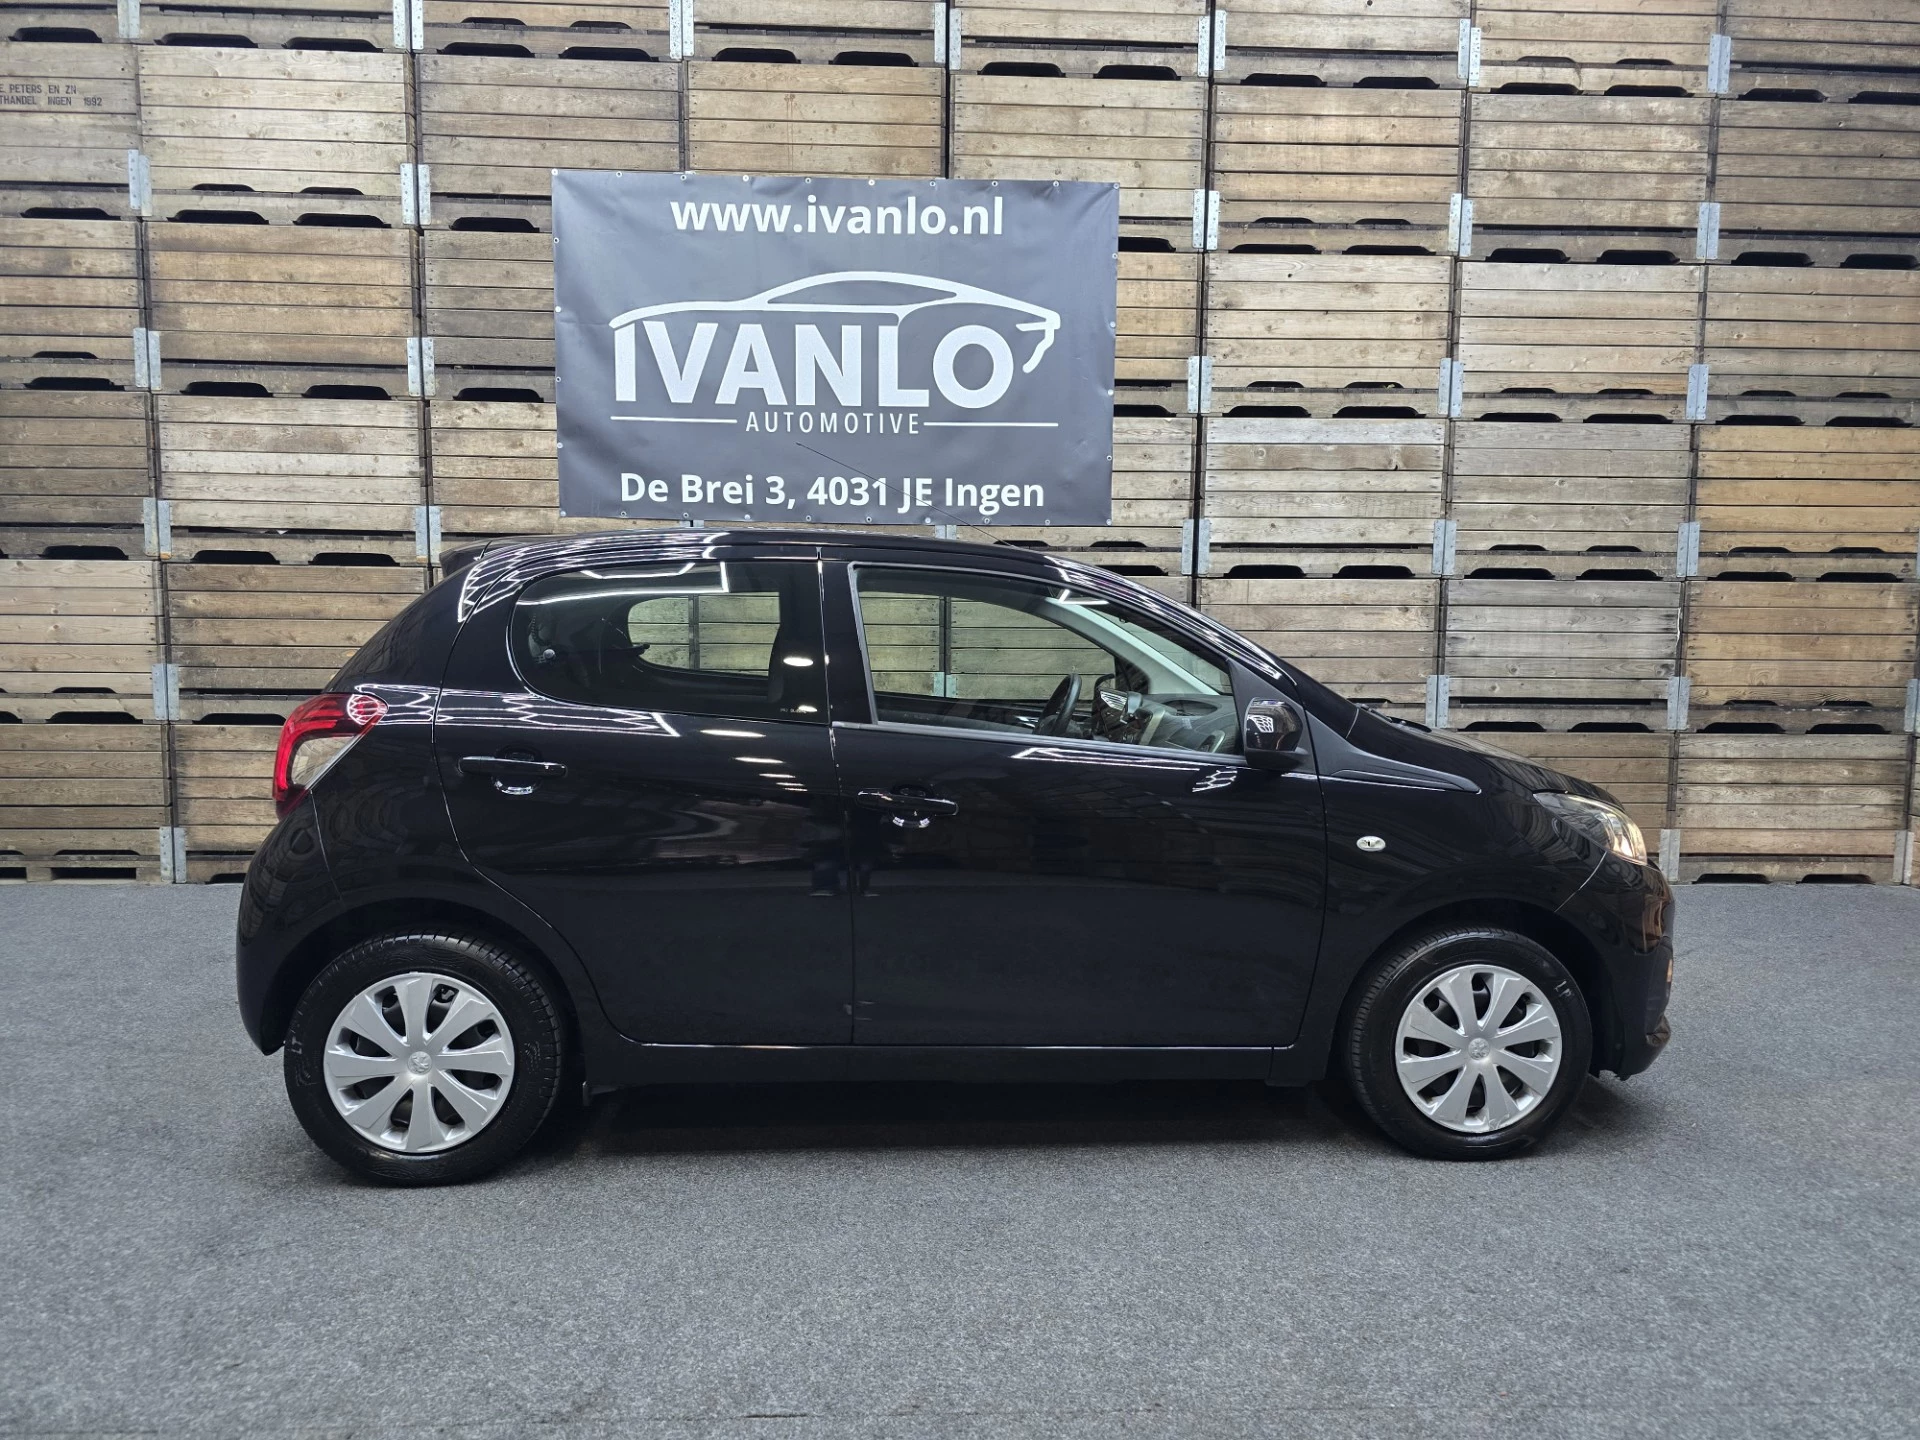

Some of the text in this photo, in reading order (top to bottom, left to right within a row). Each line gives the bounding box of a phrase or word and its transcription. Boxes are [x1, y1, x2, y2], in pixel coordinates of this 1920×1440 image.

[9, 84, 42, 94] PETERS
[48, 84, 60, 95] EN
[65, 85, 77, 95] ZN
[48, 96, 72, 106] INGEN
[83, 97, 103, 107] 1992
[669, 194, 1003, 235] www.ivanlo.nl
[613, 320, 1014, 409] IVANLO
[745, 411, 919, 435] AUTOMOTIVE
[620, 472, 1044, 516] De Brei 3, 4031 JE Ingen
